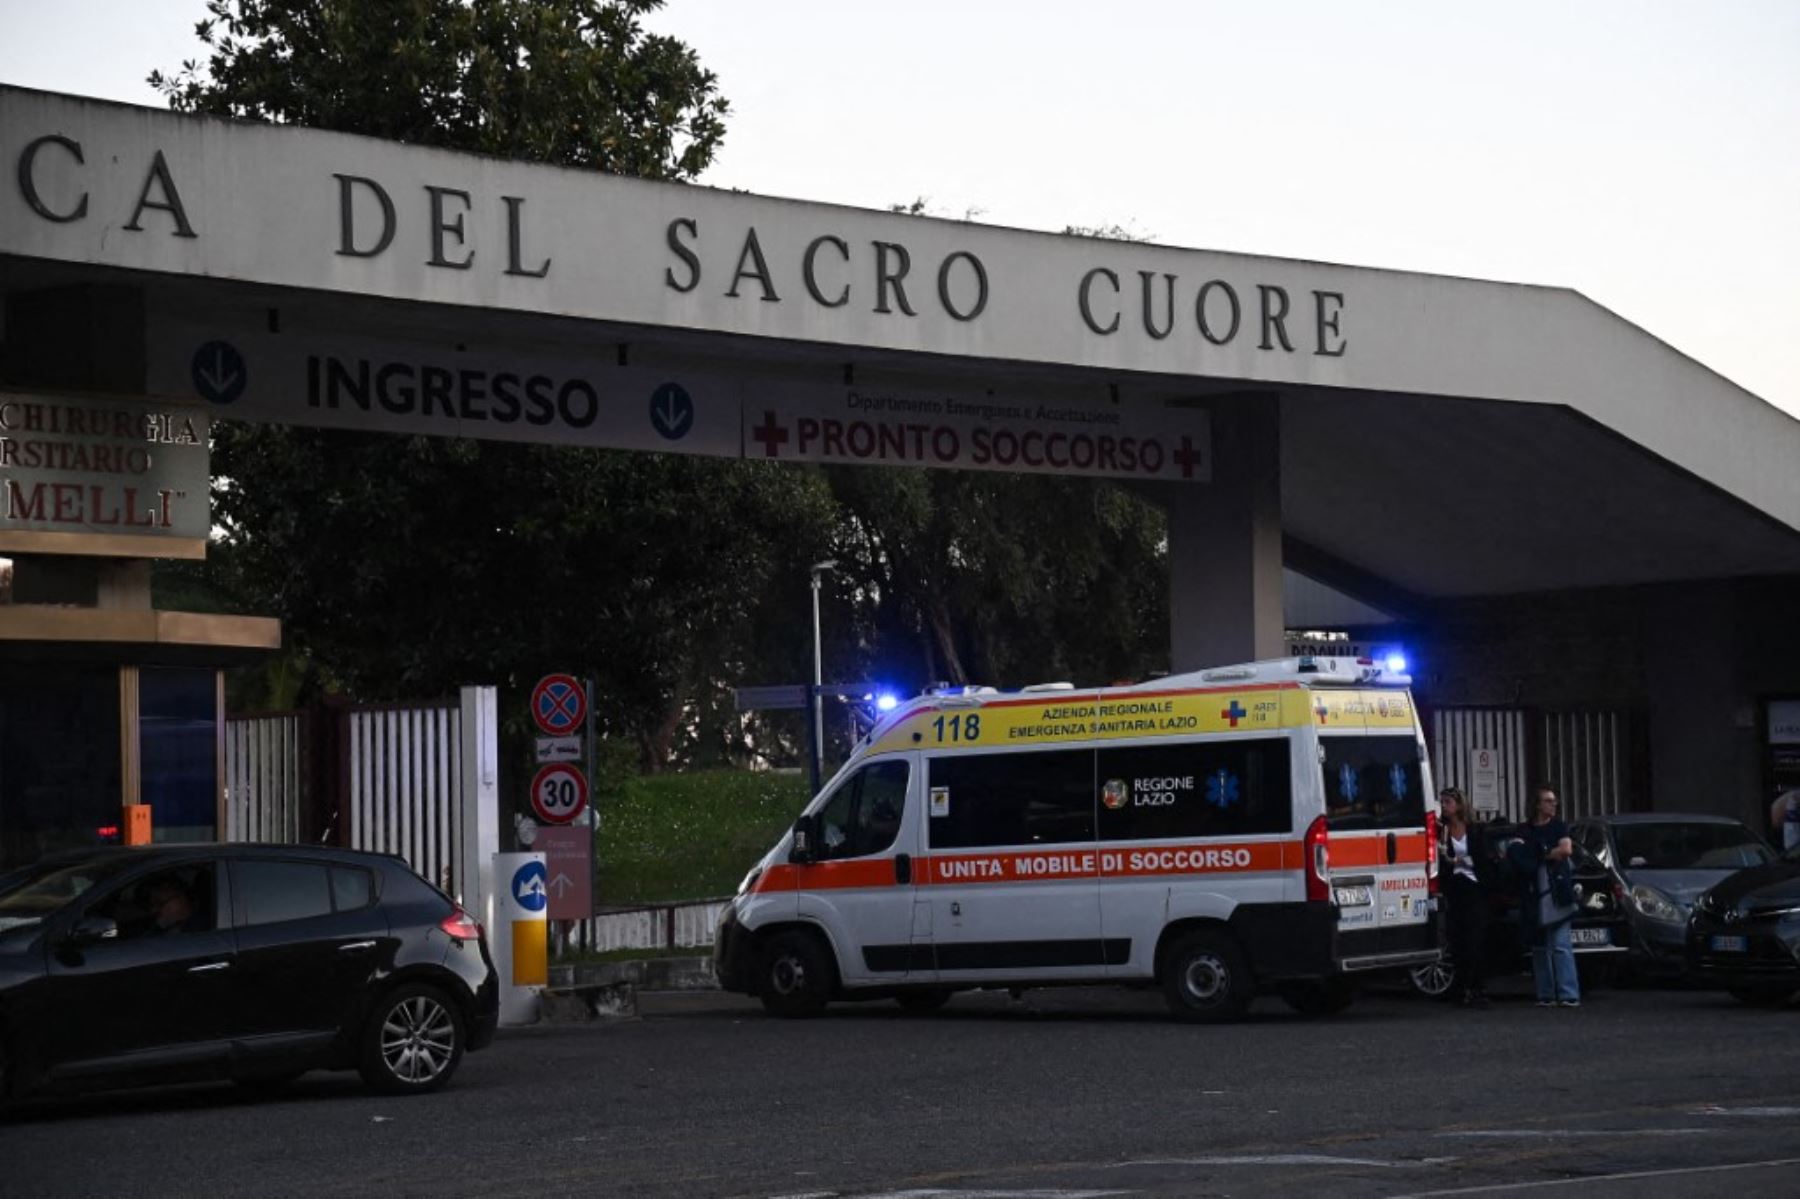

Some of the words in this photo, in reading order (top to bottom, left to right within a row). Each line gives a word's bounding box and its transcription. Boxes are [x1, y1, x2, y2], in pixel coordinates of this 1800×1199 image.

[18, 134, 198, 238] CA
[333, 173, 551, 278] DEL
[665, 218, 989, 321] SACRO
[1078, 267, 1346, 357] CUORE
[307, 355, 598, 428] INGRESSO
[0, 403, 200, 444] CHIRURGIA
[0, 437, 151, 475] RSITARIO
[799, 418, 959, 462] PRONTO
[972, 428, 1164, 473] SOCCORSO
[1042, 707, 1096, 720] AZIENDA
[1100, 701, 1173, 716] REGIONALE
[932, 714, 980, 742] 118
[1009, 724, 1087, 738] EMERGENZA
[1089, 718, 1155, 733] SANITARIA
[1160, 716, 1198, 728] LAZIO
[543, 780, 574, 806] 30
[1134, 776, 1194, 791] REGIONE
[1134, 791, 1175, 806] LAZIO
[1015, 855, 1095, 874] MOBILE
[1103, 854, 1123, 871] DI
[1130, 848, 1250, 870] SOCCORSO
